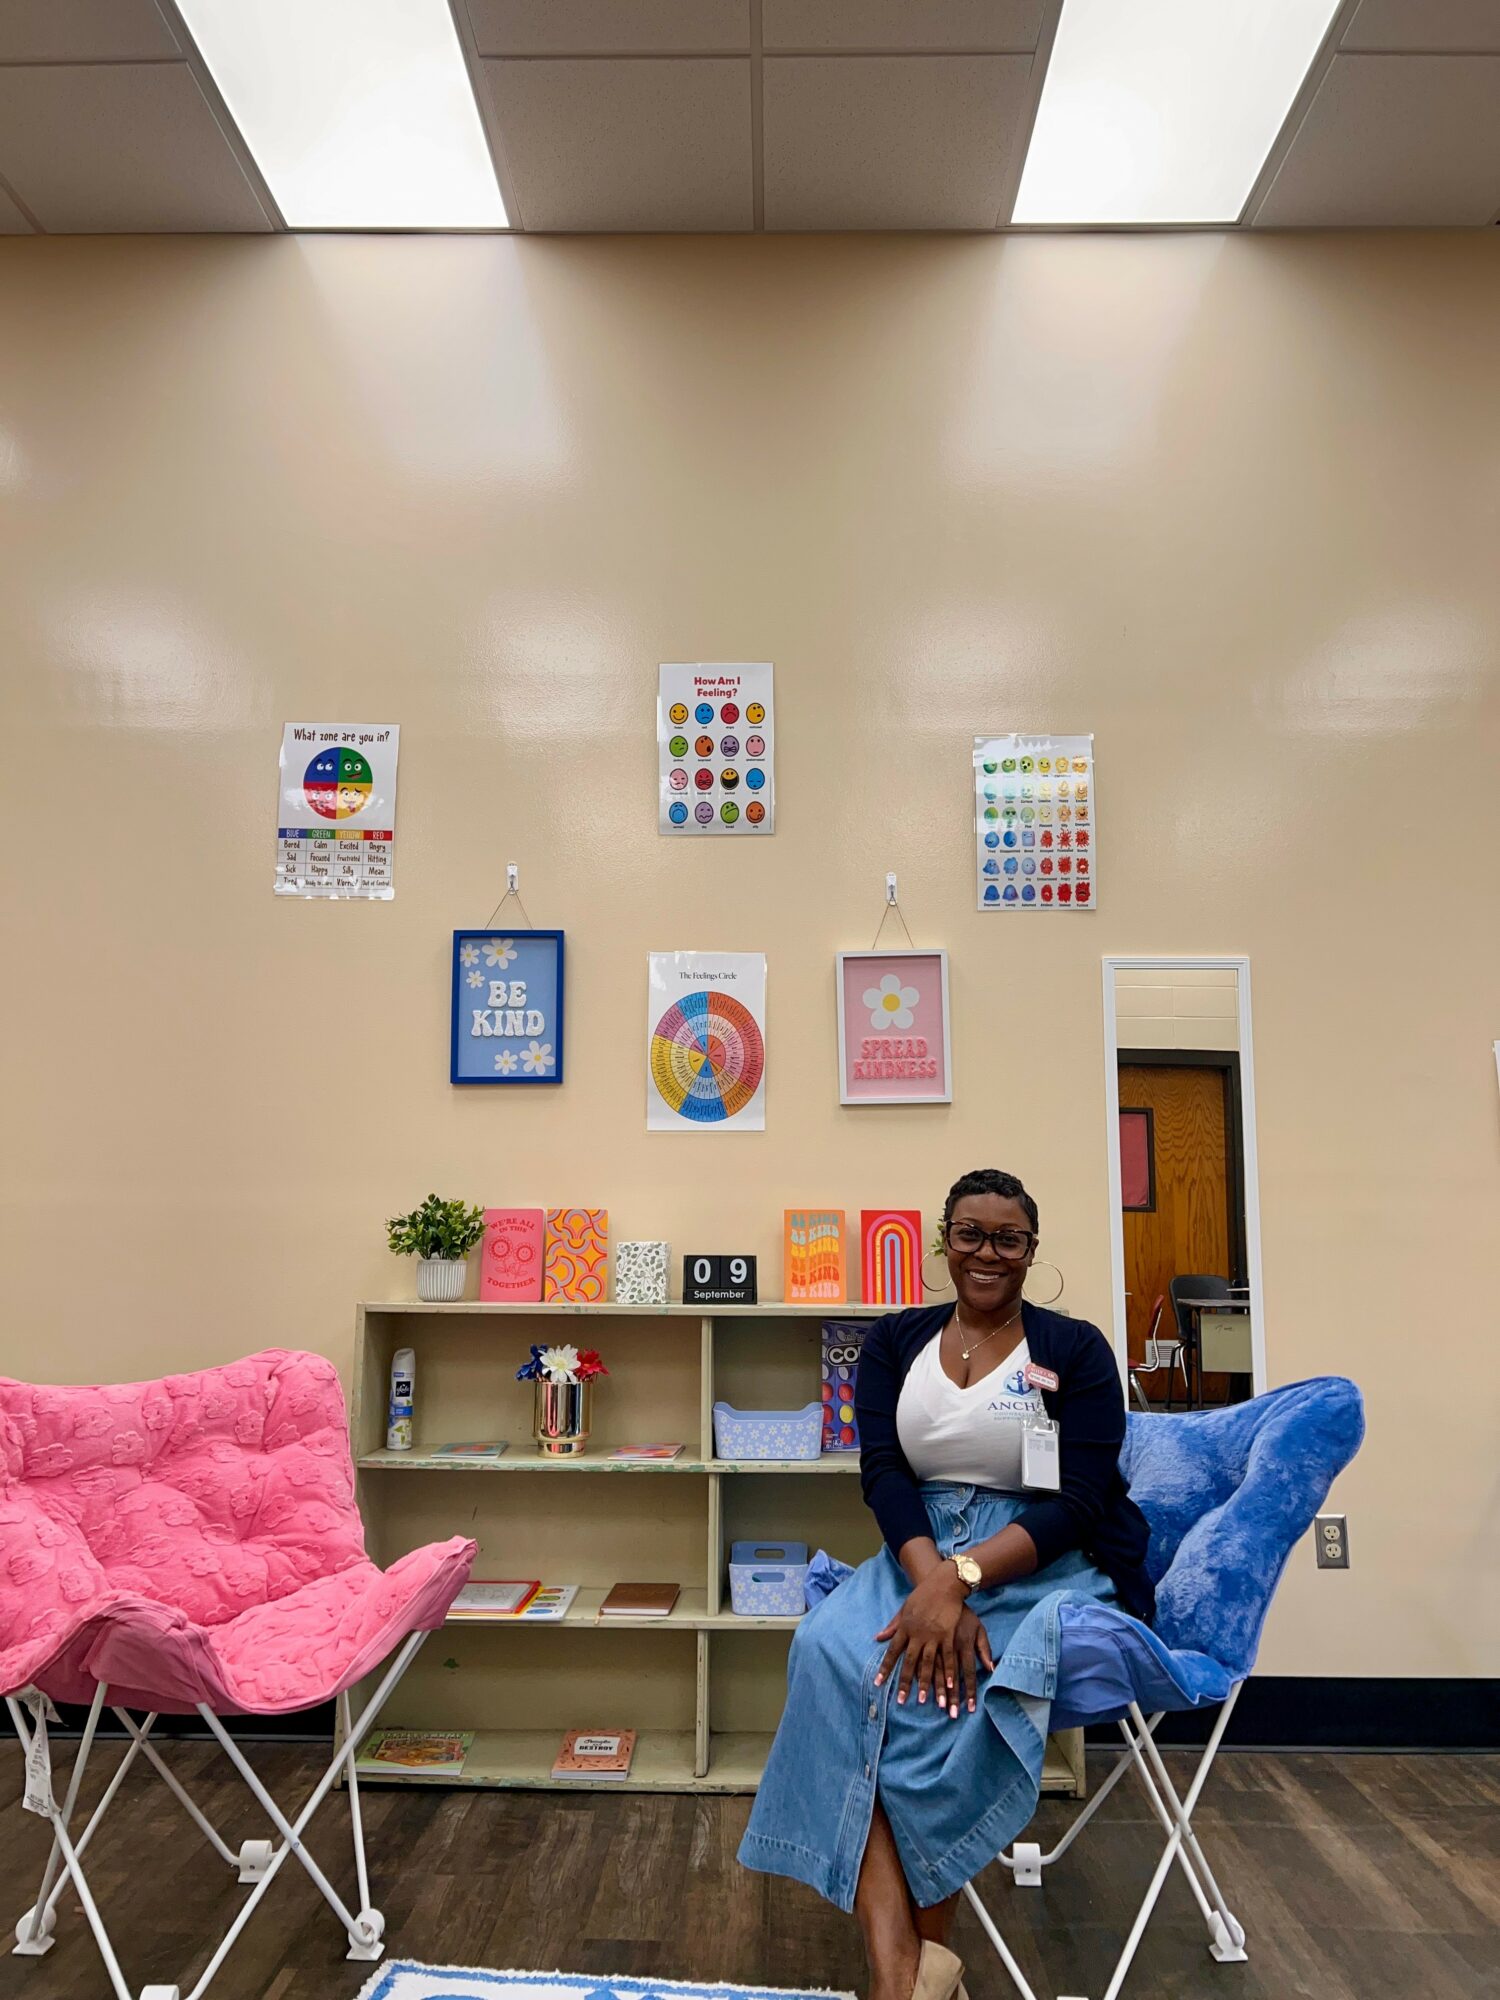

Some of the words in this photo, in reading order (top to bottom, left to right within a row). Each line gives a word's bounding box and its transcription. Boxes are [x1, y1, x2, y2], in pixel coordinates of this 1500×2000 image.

[694, 677, 716, 686] How
[717, 676, 735, 685] Am
[736, 676, 741, 685] I
[697, 687, 737, 699] Feeling?
[294, 728, 316, 742] What
[319, 733, 338, 743] zone
[342, 733, 356, 743] are
[359, 735, 374, 746] you
[377, 730, 390, 743] in?
[311, 829, 331, 840] GREEN
[372, 831, 385, 841] RED
[284, 840, 301, 849] Bored
[313, 840, 328, 849] Calm
[339, 841, 359, 851] Excited
[369, 842, 386, 853] Angry
[286, 852, 297, 862] Sad
[310, 852, 330, 863] Focused
[336, 854, 361, 863] Frustrated
[367, 854, 387, 865] Hitting
[285, 864, 297, 873] Sick
[311, 865, 329, 876] Happy
[342, 865, 355, 875] Silly
[368, 866, 385, 875] Mean
[680, 971, 692, 980] The
[692, 971, 718, 981] Feelings
[718, 971, 738, 980] Circle
[487, 980, 528, 1008] BE
[471, 1009, 546, 1038] KIND
[861, 1036, 929, 1059] SPREAD
[853, 1057, 938, 1080] KINDNESS
[490, 1217, 518, 1230] WE'RE
[519, 1218, 536, 1231] ALL
[498, 1225, 509, 1234] IN
[510, 1225, 528, 1233] THIS
[790, 1228, 807, 1246] BE
[808, 1224, 840, 1243] KIND
[790, 1242, 807, 1259] BE
[808, 1235, 840, 1258] KIND
[791, 1271, 807, 1287] BE
[808, 1265, 840, 1285] KIND
[487, 1276, 537, 1290] TOGETHER
[693, 1289, 746, 1301] September
[791, 1285, 807, 1299] BE
[808, 1280, 841, 1299] KIND
[987, 1400, 1037, 1412] ANCH
